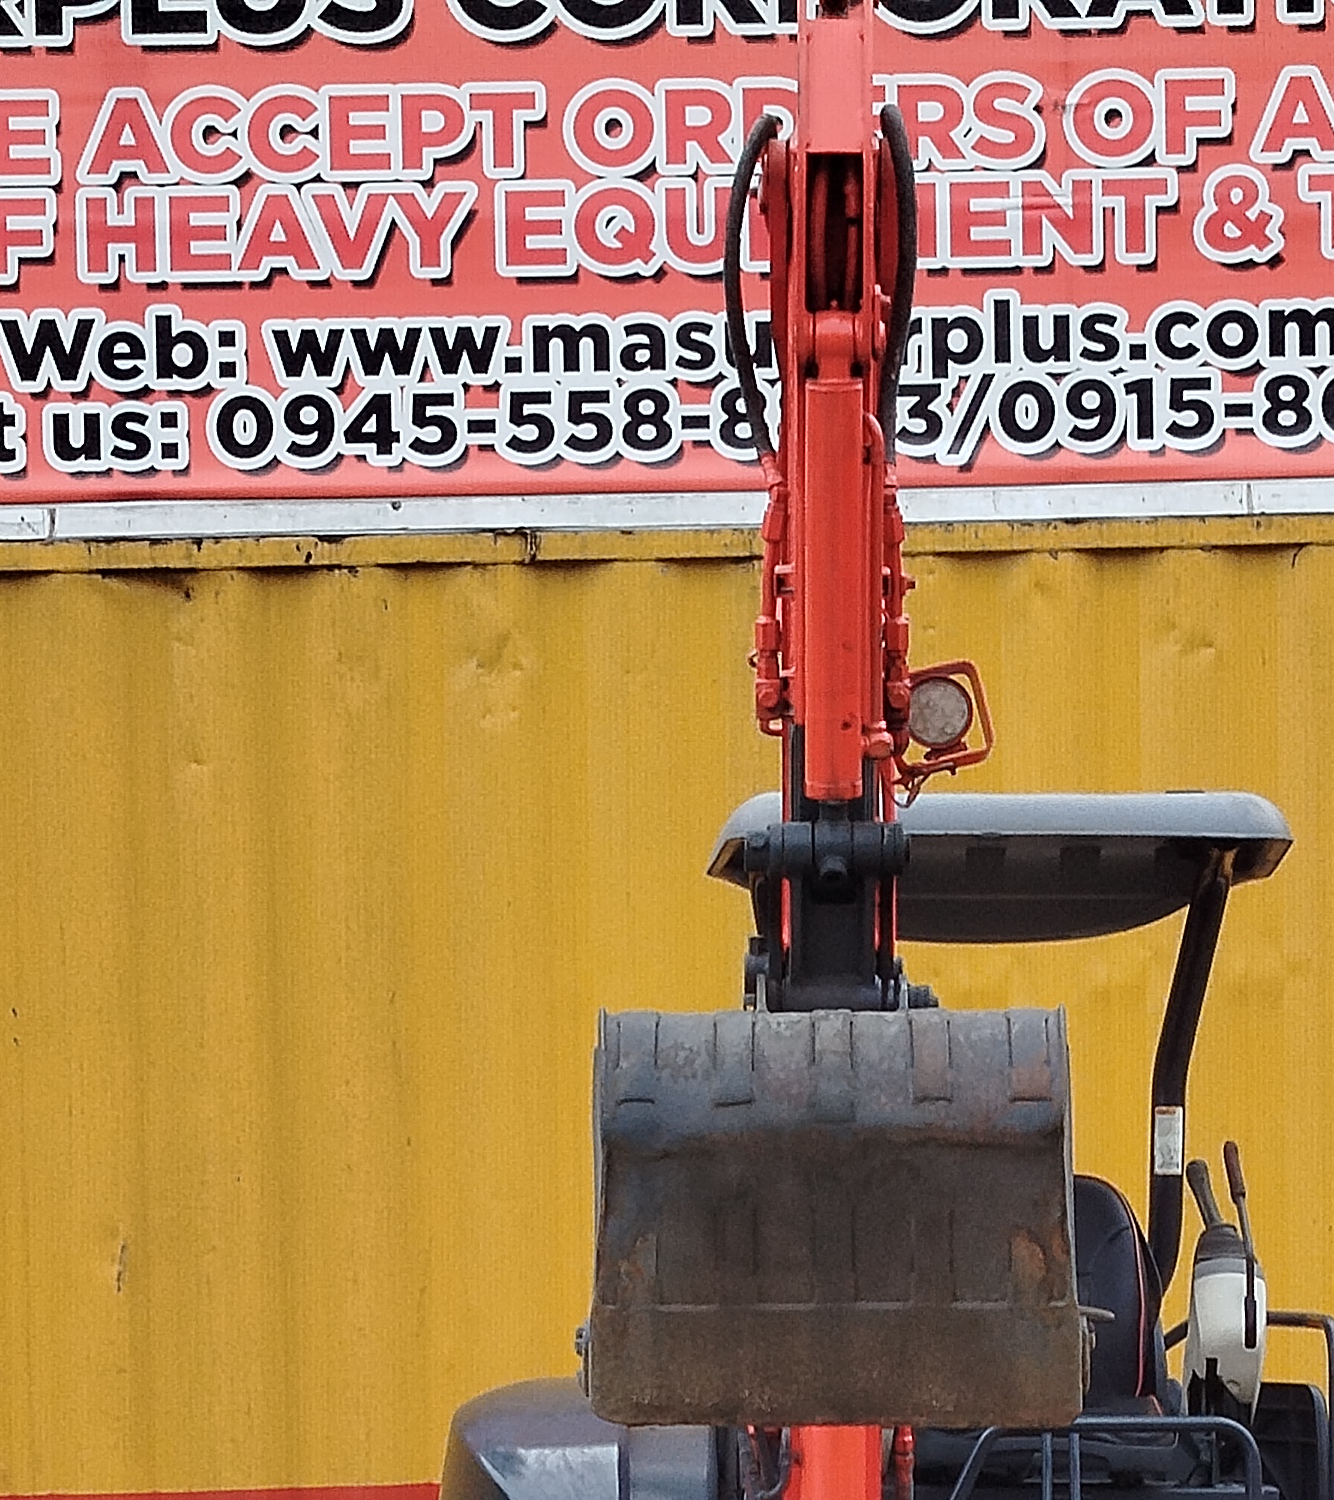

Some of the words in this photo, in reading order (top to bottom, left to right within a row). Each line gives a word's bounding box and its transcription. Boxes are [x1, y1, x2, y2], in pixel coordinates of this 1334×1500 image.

[79, 81, 545, 184] ACCEPT
[565, 72, 1044, 178] ORDRS
[1065, 68, 1234, 168] OF
[78, 182, 476, 283] HEAVY
[494, 170, 1176, 277] EQUIENT
[1194, 166, 1283, 262] &
[43, 399, 188, 472] us:
